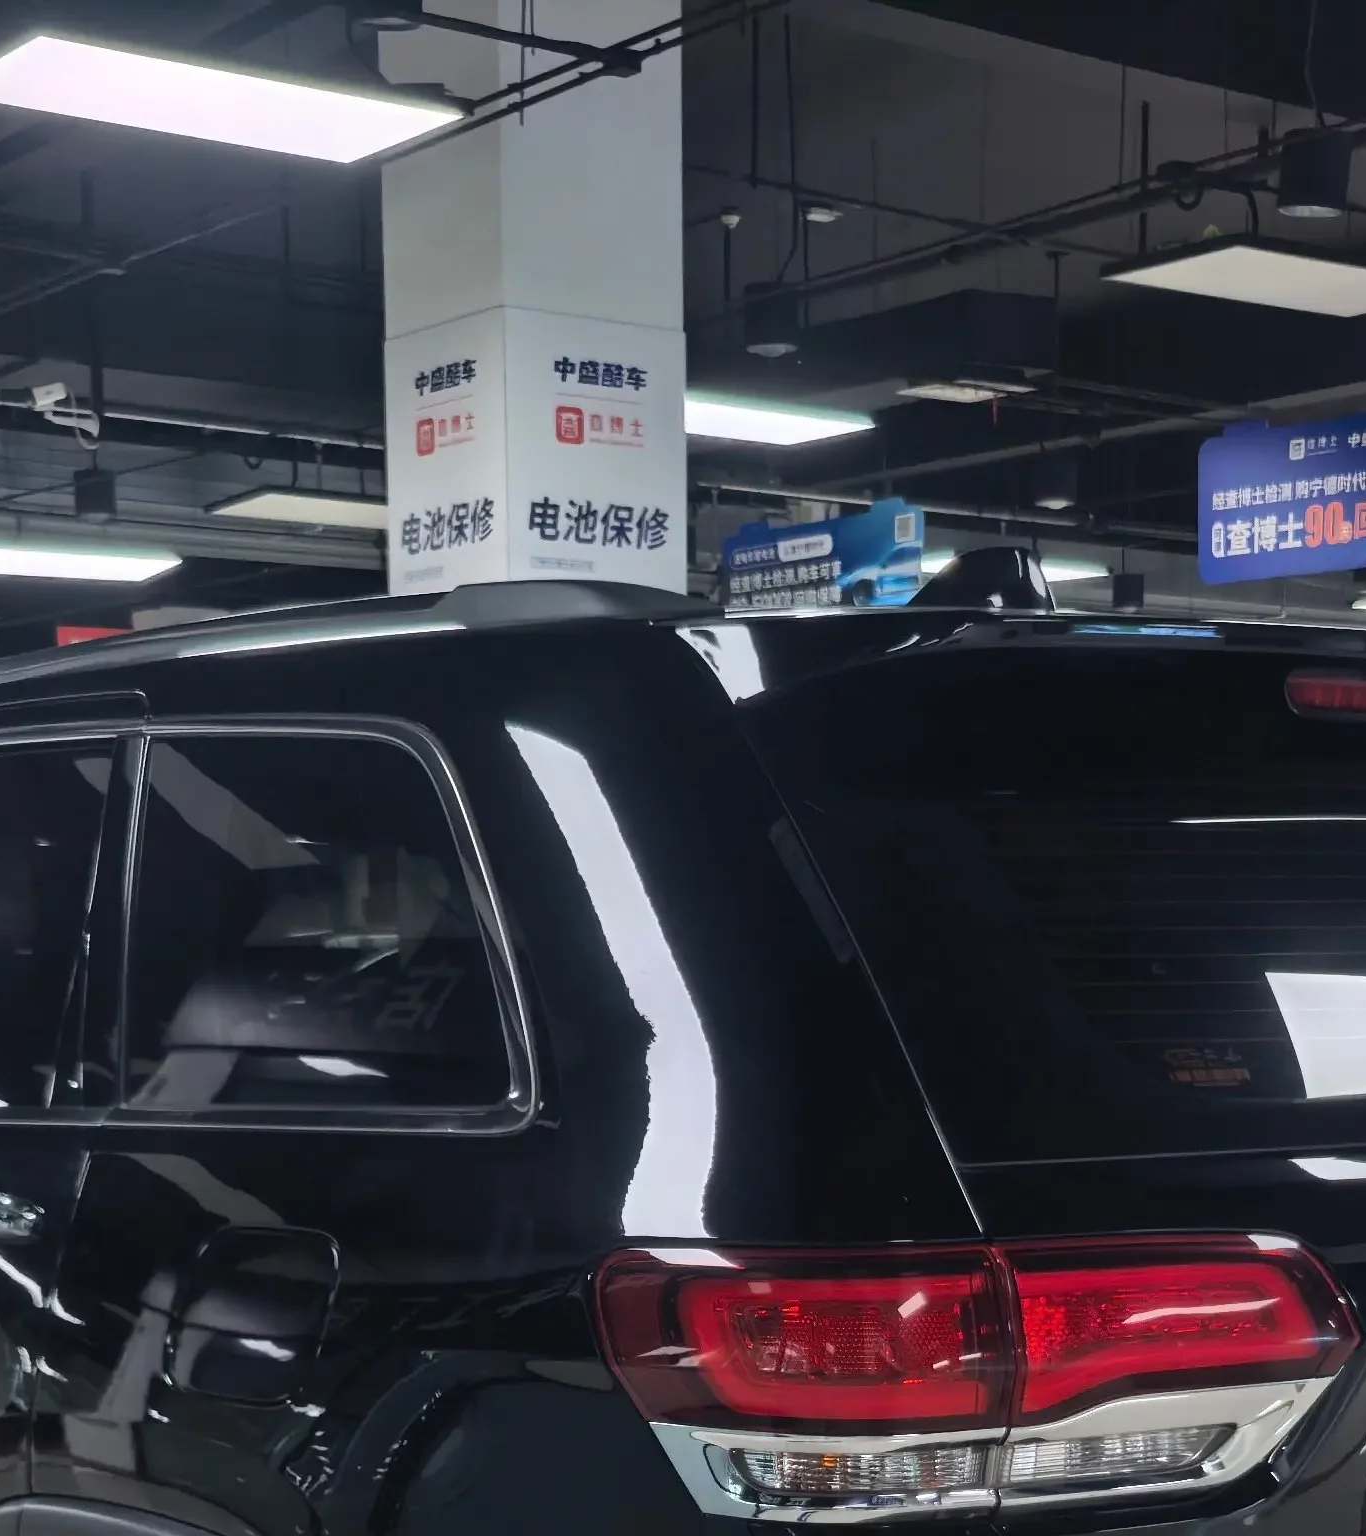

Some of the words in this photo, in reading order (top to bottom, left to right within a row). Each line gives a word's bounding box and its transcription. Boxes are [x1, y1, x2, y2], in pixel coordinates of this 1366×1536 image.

[554, 356, 647, 391] 中盛酷车
[401, 497, 494, 555] 电池保修
[528, 496, 669, 550] 电池保修
